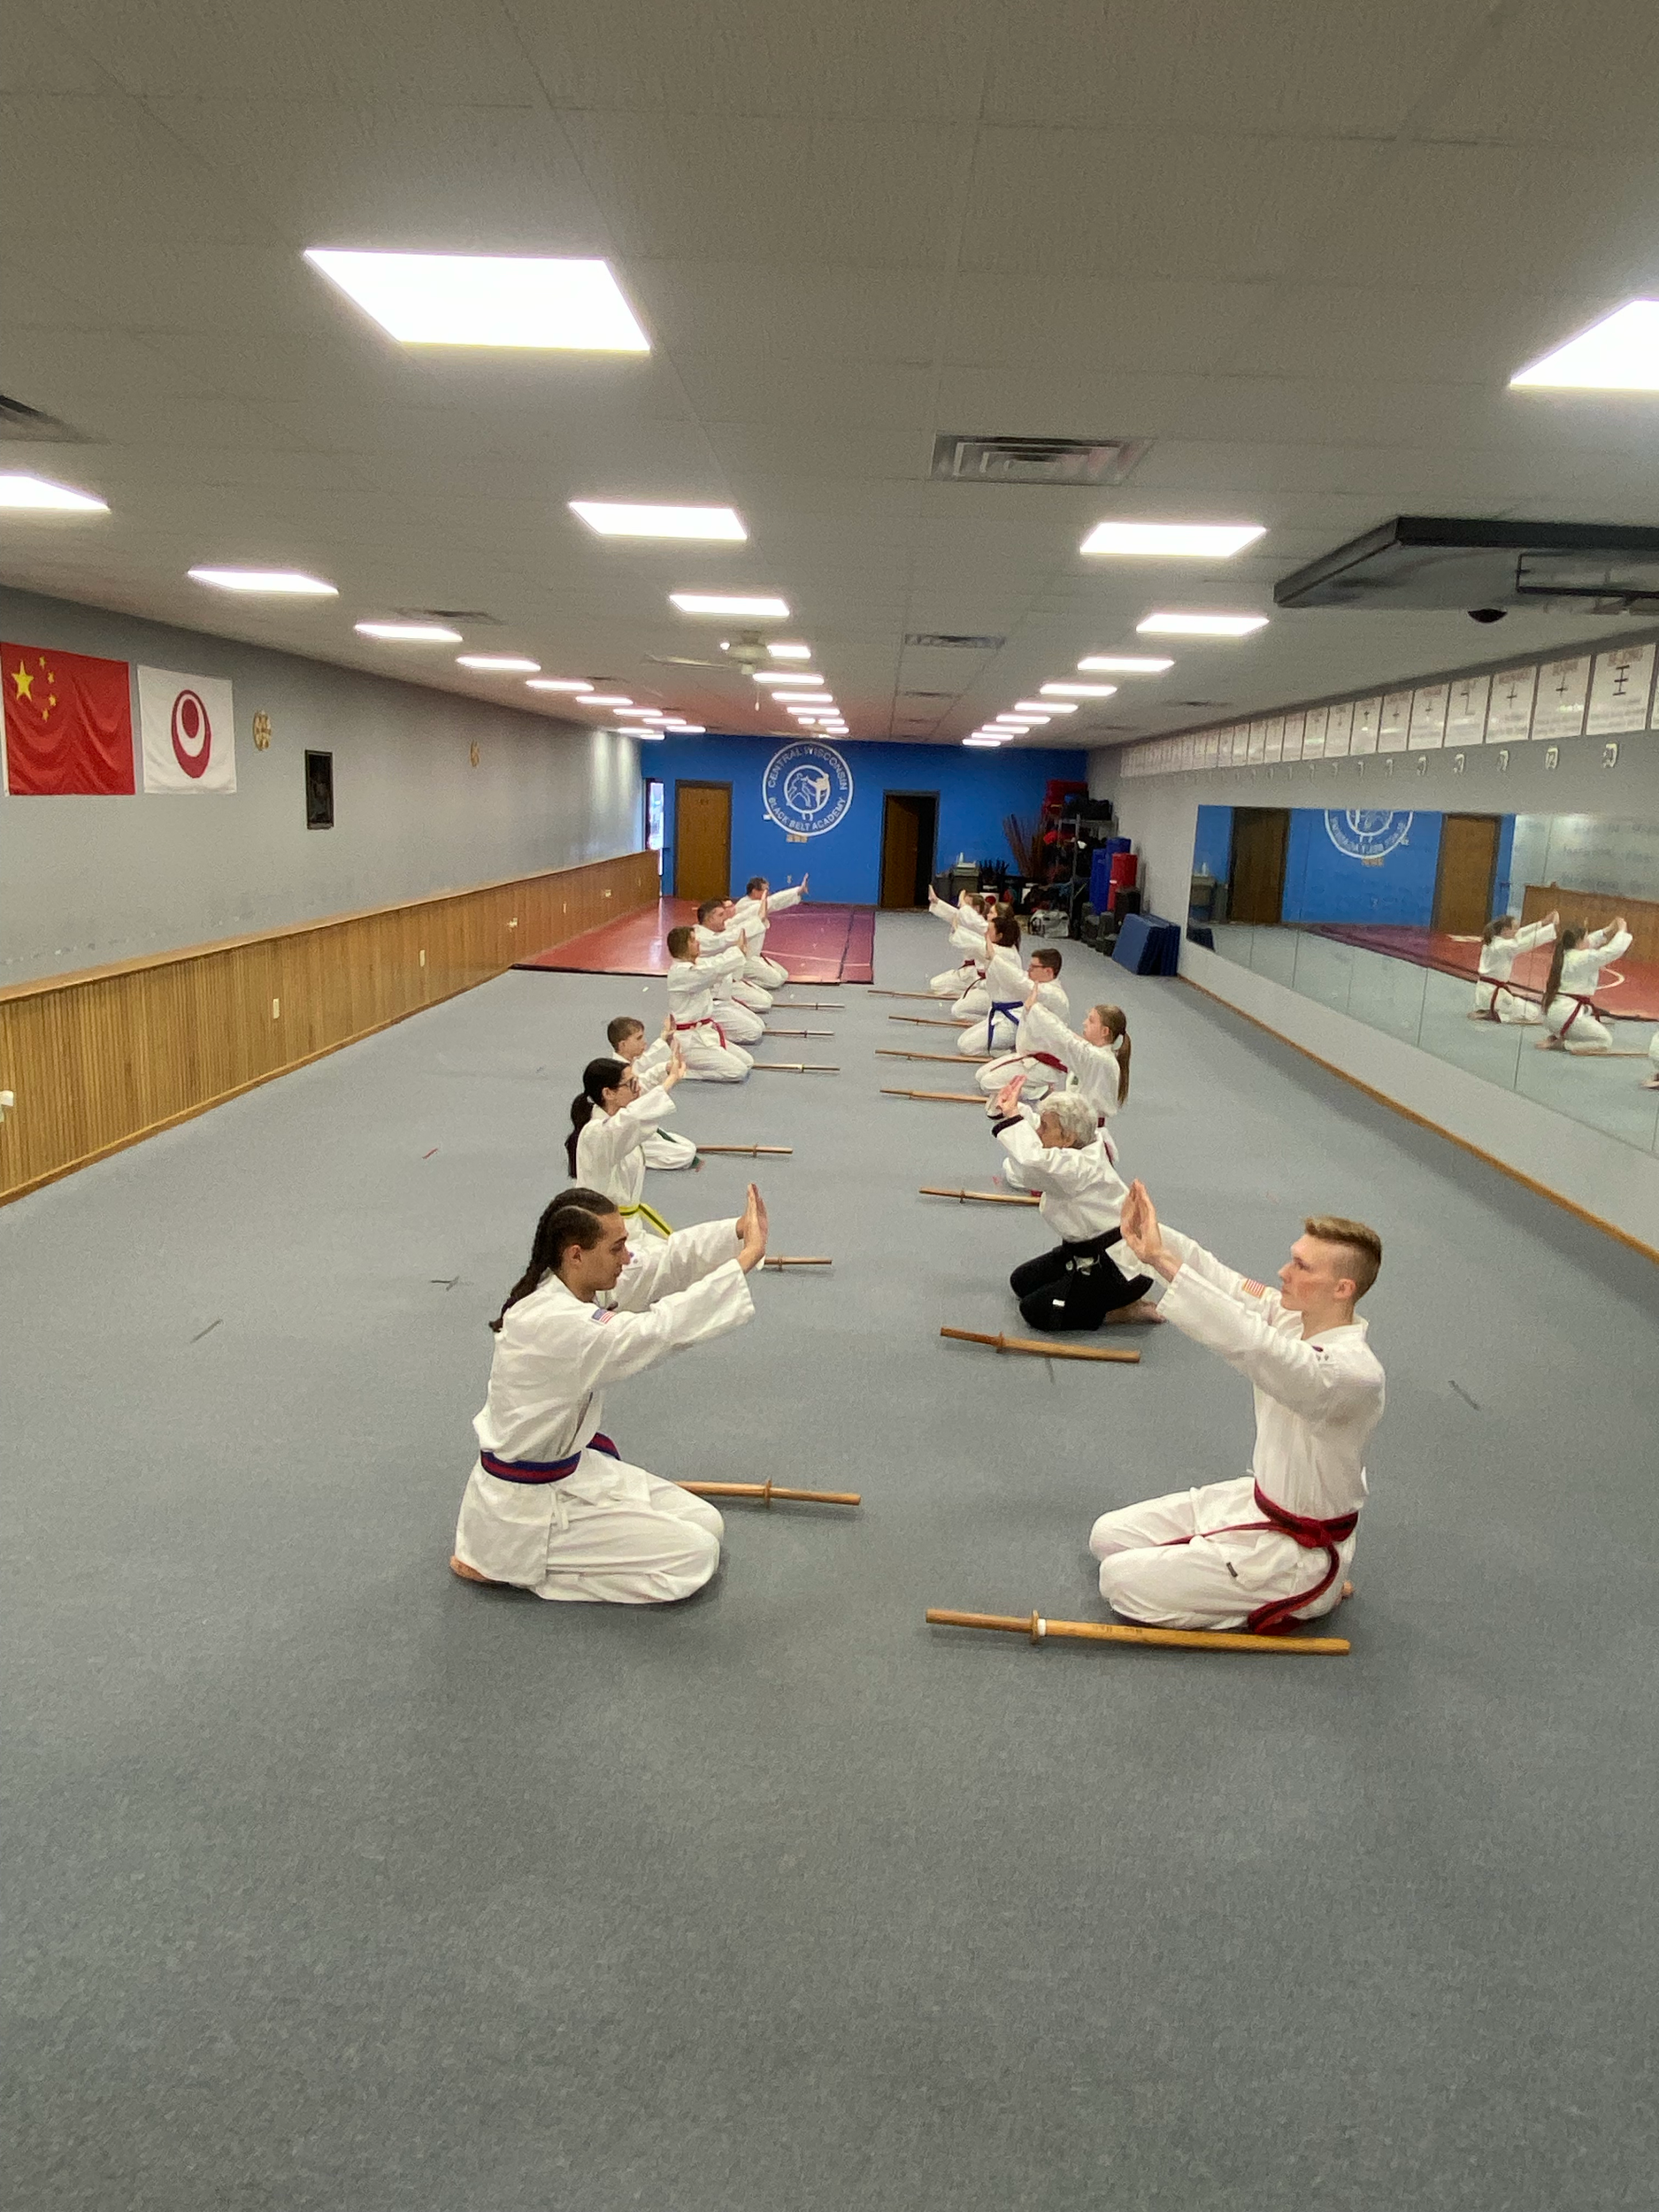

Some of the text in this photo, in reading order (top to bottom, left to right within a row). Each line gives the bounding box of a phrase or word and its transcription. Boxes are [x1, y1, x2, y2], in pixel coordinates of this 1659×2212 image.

[768, 746, 848, 791] CENTRAL WISCONSIN
[768, 796, 846, 831] BLACK BELT ACADEMY
